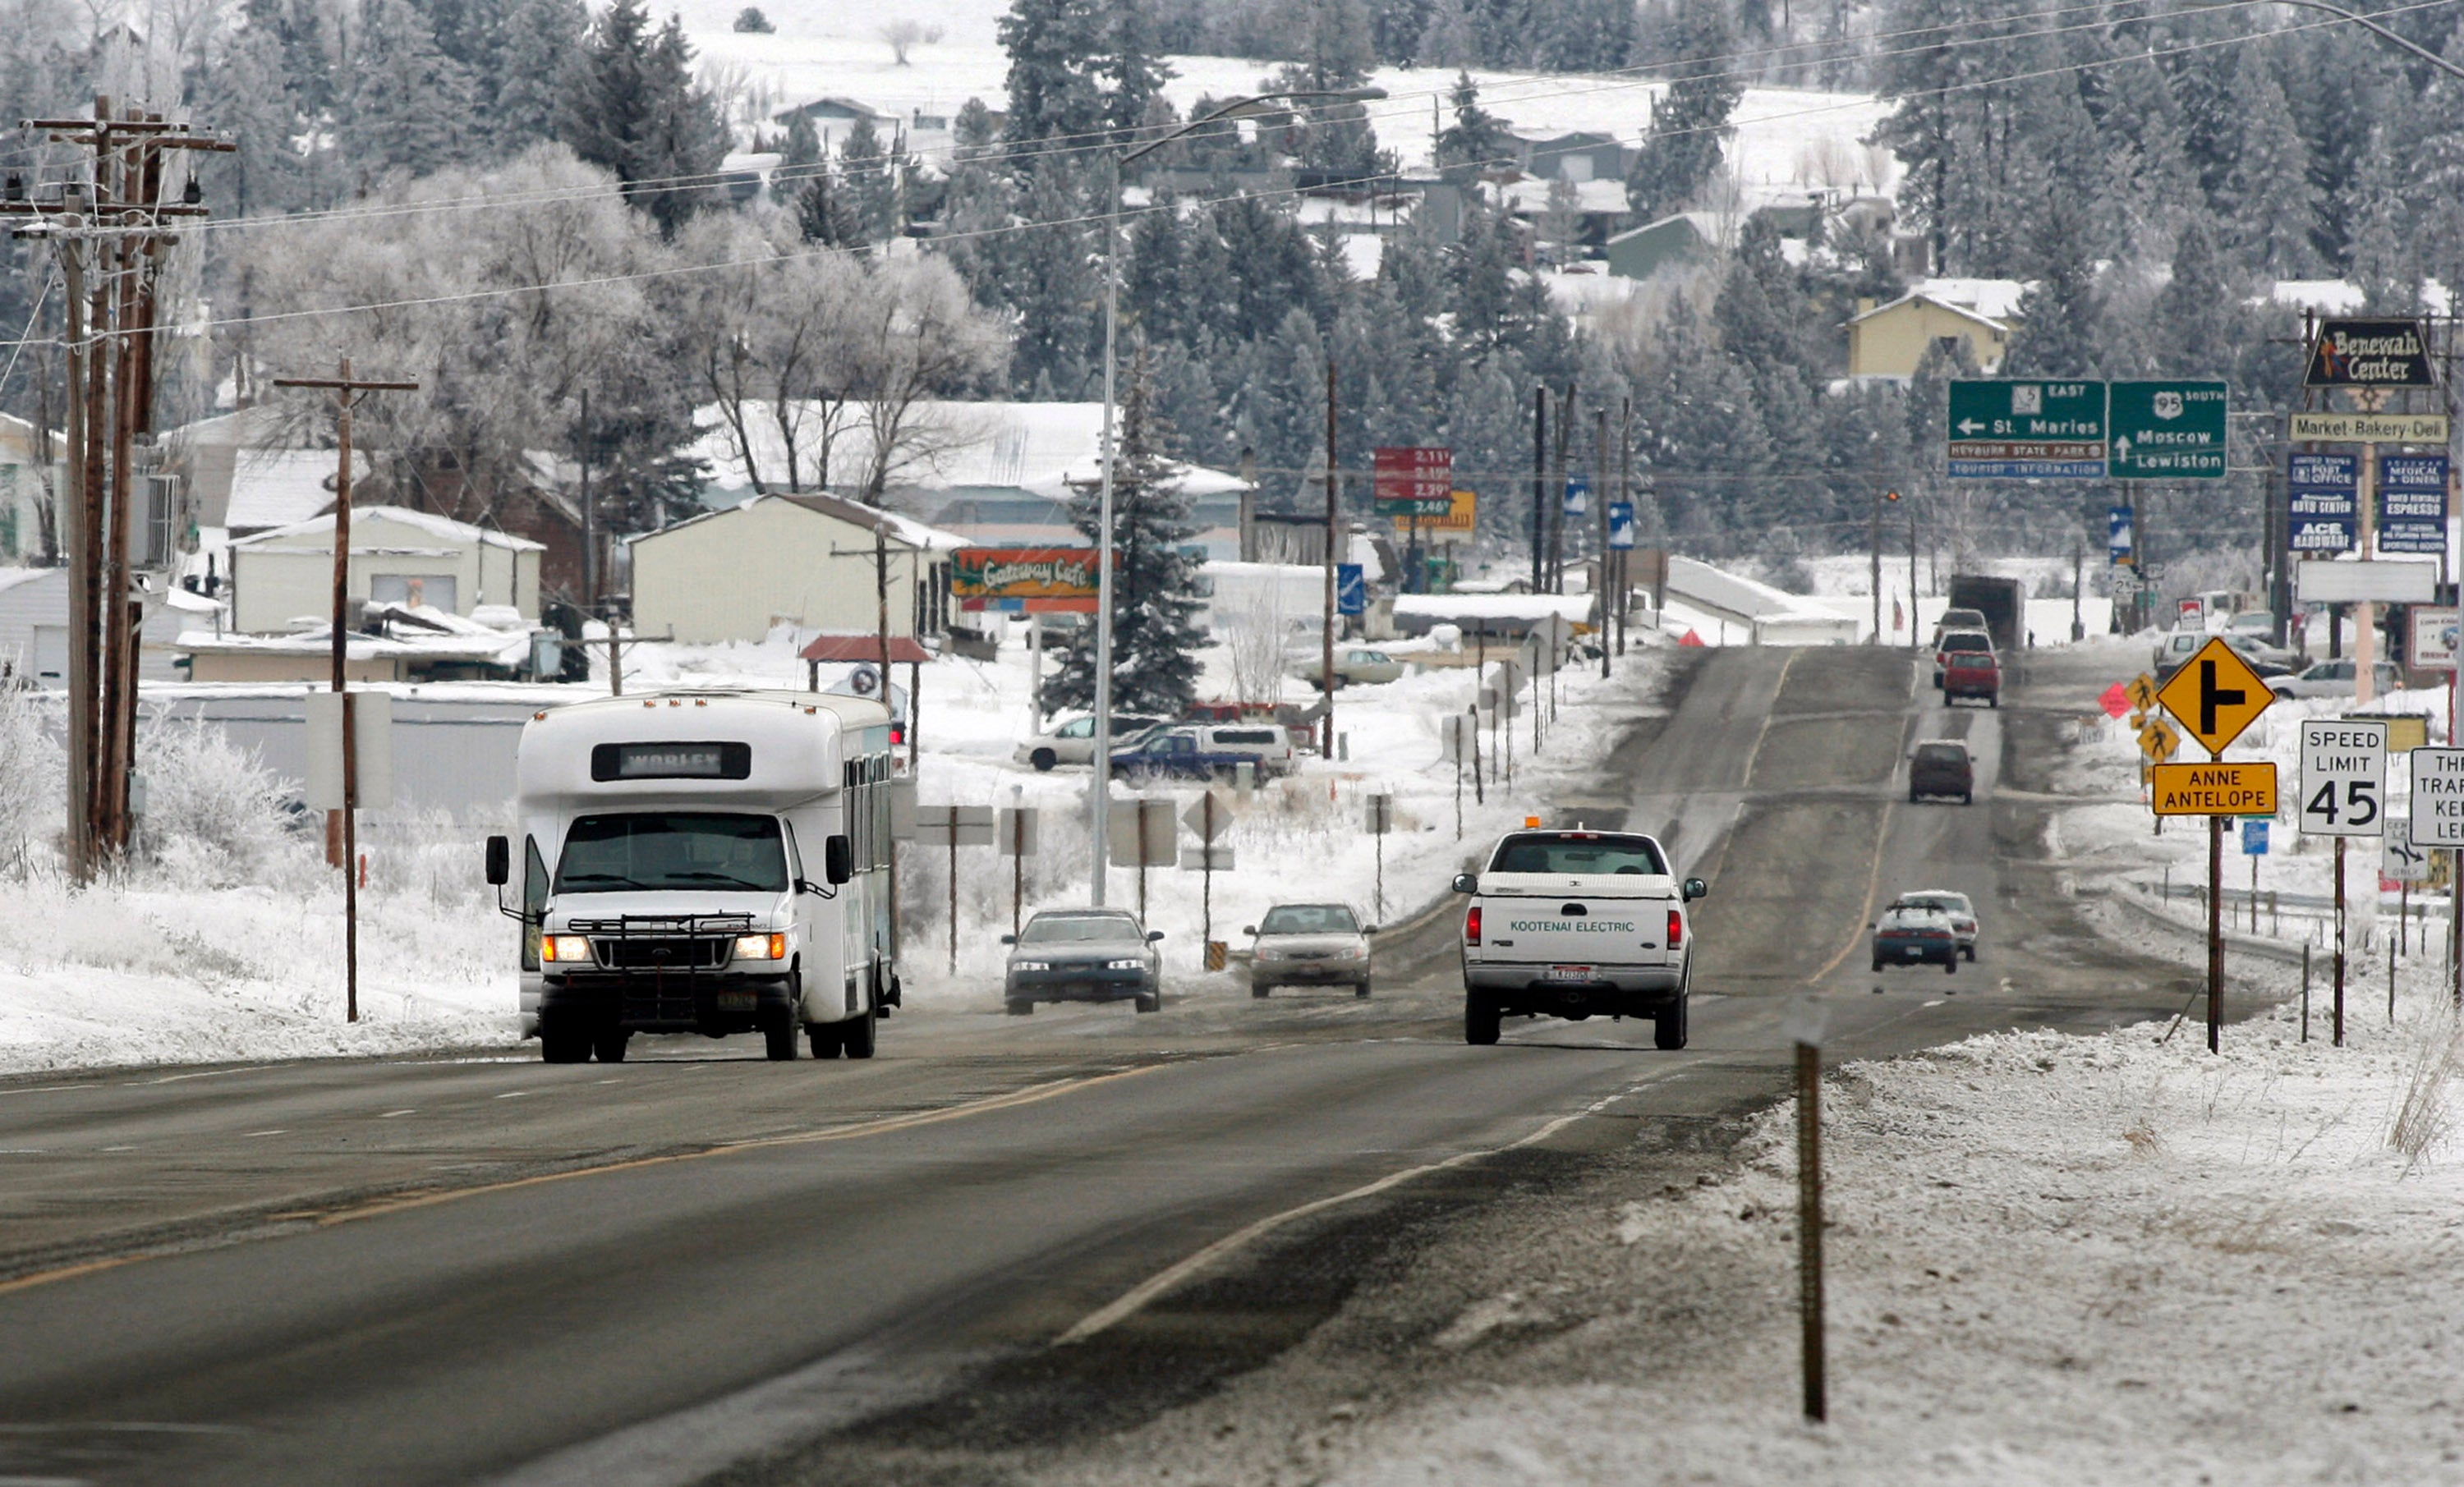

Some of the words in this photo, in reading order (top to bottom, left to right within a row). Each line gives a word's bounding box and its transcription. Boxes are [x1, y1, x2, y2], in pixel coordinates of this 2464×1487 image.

[2334, 331, 2420, 356] Benewah
[2347, 357, 2410, 380] Center
[2048, 384, 2086, 397] EAST
[2186, 391, 2224, 401] SOUTH
[2158, 397, 2180, 411] 95
[1993, 420, 2016, 434] St.
[2030, 419, 2099, 434] Maries
[2296, 420, 2347, 436] Market
[2356, 420, 2407, 439] Bakery
[2413, 420, 2442, 437] Deli
[2136, 429, 2211, 443] Moscow
[1951, 445, 2007, 456] HEYBURN
[2013, 446, 2048, 456] STATE
[2054, 446, 2086, 456] PARK
[2136, 452, 2221, 468] Lewiston
[1955, 464, 2006, 474] TOURIST
[2015, 464, 2100, 475] INFORMATION
[2311, 465, 2341, 473] POST
[2389, 466, 2438, 475] MEDICAL
[2311, 473, 2351, 484] OFFICE
[2292, 500, 2316, 513] AUTO
[2319, 500, 2351, 513] CENTER
[2387, 503, 2441, 516] ESPRESSO
[2301, 523, 2342, 535] ACE
[2293, 535, 2349, 548] HARDWARE
[984, 560, 1051, 588] Gateway
[1055, 558, 1087, 587] Cafe
[2310, 732, 2379, 747] SPEED
[628, 753, 720, 766] WORLEY
[2316, 756, 2370, 772] LIMIT
[2436, 755, 2464, 772] TH
[2189, 770, 2241, 786] ANNE
[2164, 791, 2265, 808] ANTELOPE
[2306, 780, 2377, 826] 45
[2393, 868, 2418, 876] ONLY
[1510, 921, 1571, 932] KOOTENAI
[1576, 921, 1634, 933] ELECTRIC
